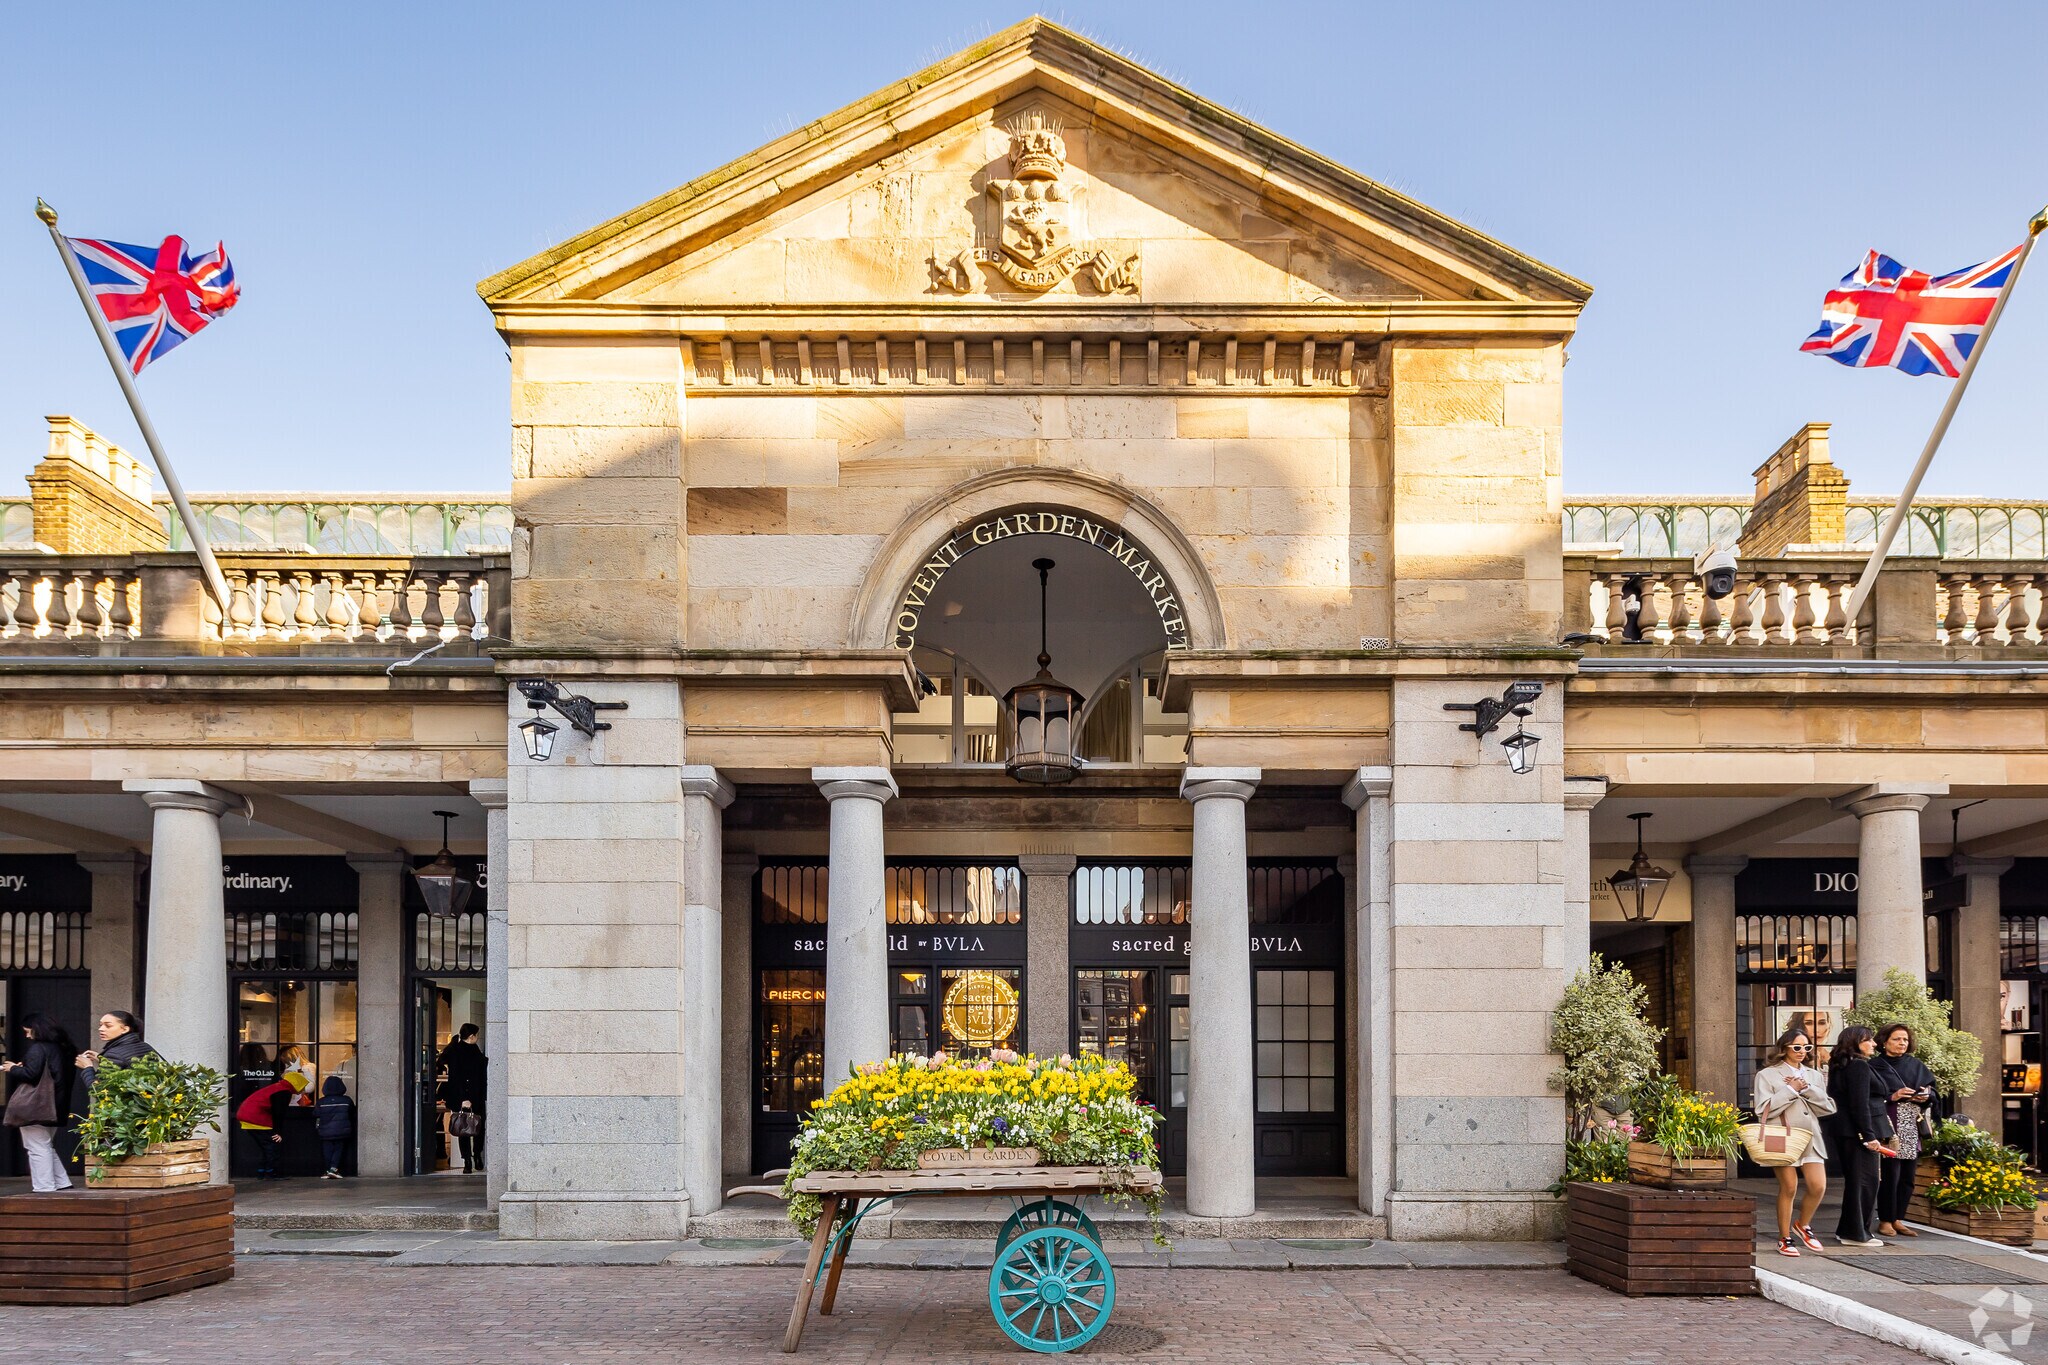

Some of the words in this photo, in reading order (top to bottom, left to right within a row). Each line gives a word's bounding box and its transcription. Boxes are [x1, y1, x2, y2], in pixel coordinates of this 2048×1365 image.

[1020, 271, 1055, 283] SARA
[893, 538, 960, 652] COVENT
[972, 512, 1103, 545] GARDEN
[1107, 536, 1187, 651] MARKET
[222, 872, 293, 893] rdinary.
[794, 938, 829, 951] sac
[1112, 936, 1175, 952] sacred
[769, 990, 825, 1000] PIERCN
[962, 992, 999, 1002] sacred
[923, 1151, 972, 1162] COVENT
[983, 1150, 1032, 1161] GARDEN
[1000, 1320, 1034, 1347] GARDEN
